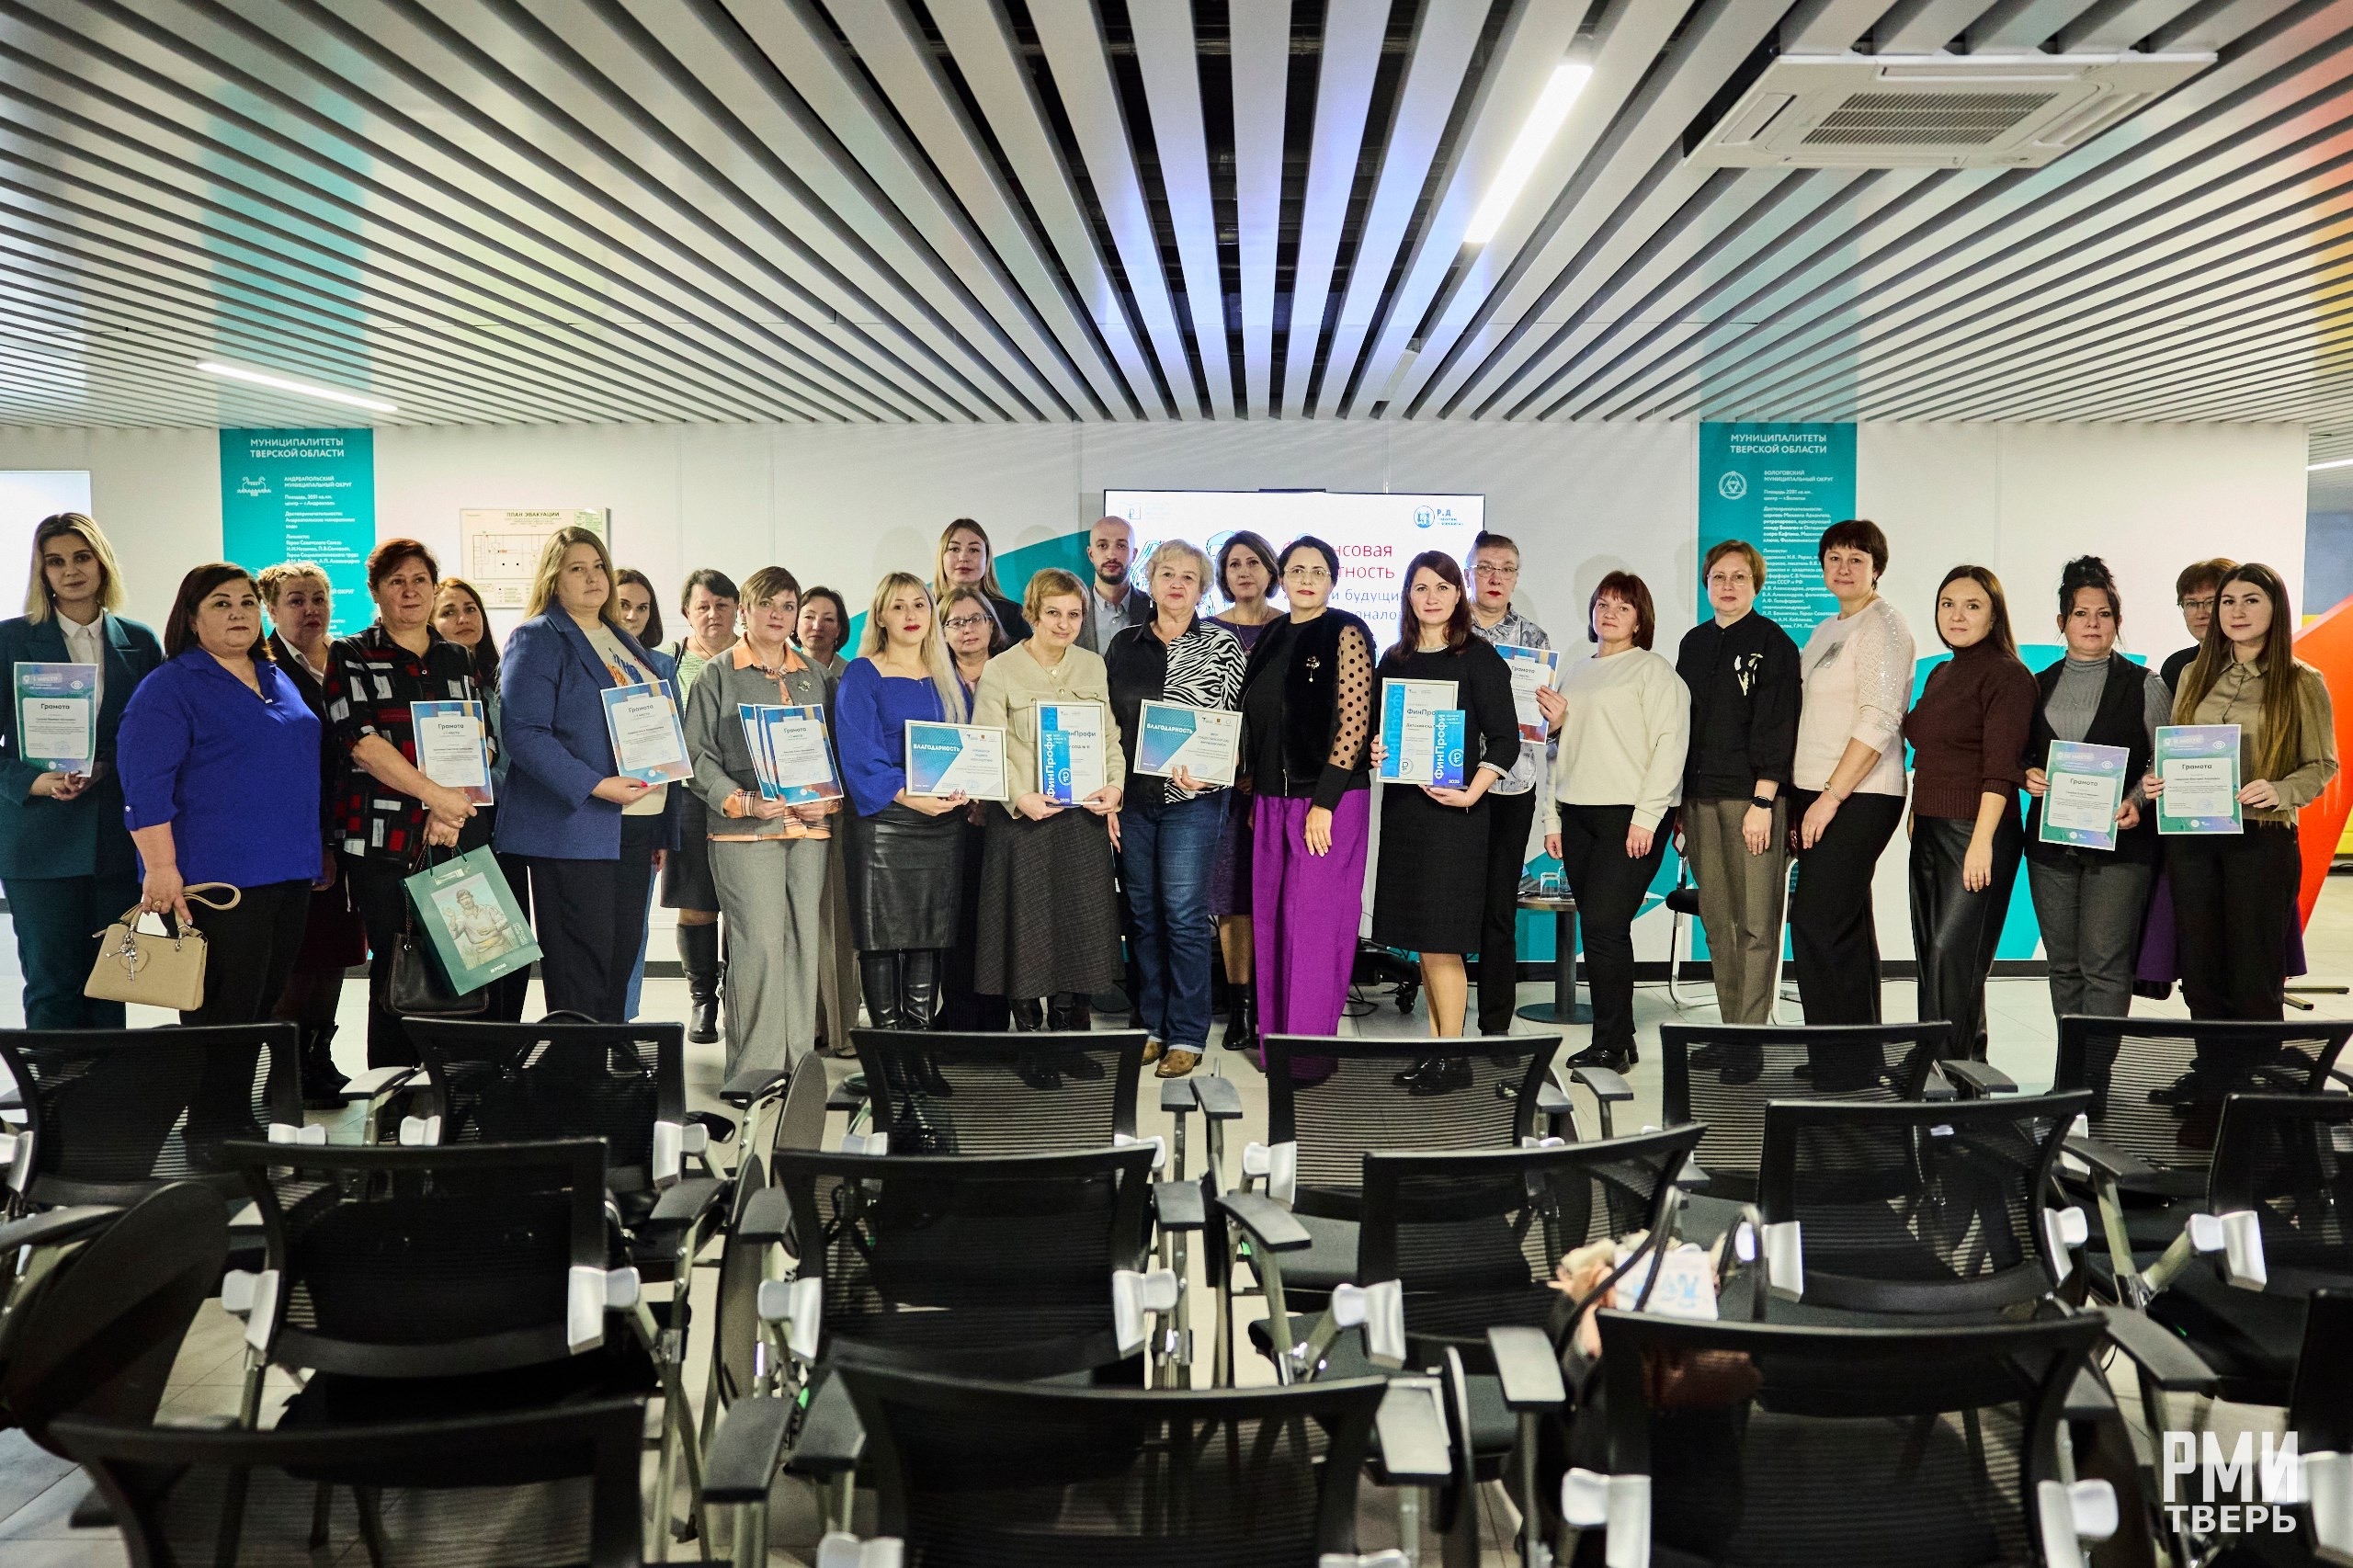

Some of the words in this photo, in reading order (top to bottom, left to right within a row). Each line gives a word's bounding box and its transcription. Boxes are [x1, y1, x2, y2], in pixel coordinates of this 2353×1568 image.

[250, 437, 344, 448] МУНИЦИПАЛИТЕТЫ
[1731, 434, 1827, 443] МУНИЦИПАЛИТЕТЫ
[250, 449, 298, 458] ТВЕРСКОЙ
[300, 449, 345, 458] ОБЛАСТИ
[1730, 445, 1779, 454] ТВЕРСКОЙ
[1780, 445, 1827, 454] ОБЛАСТИ
[628, 703, 654, 714] Грамота
[1406, 708, 1436, 716] ФинПро
[1146, 722, 1193, 734] БЛАГОДАРНОСТЬ
[913, 744, 961, 752] БЛАГОДАРНОСТЬ
[1434, 714, 1449, 779] ФинПрофи
[2070, 778, 2098, 787] Грамота
